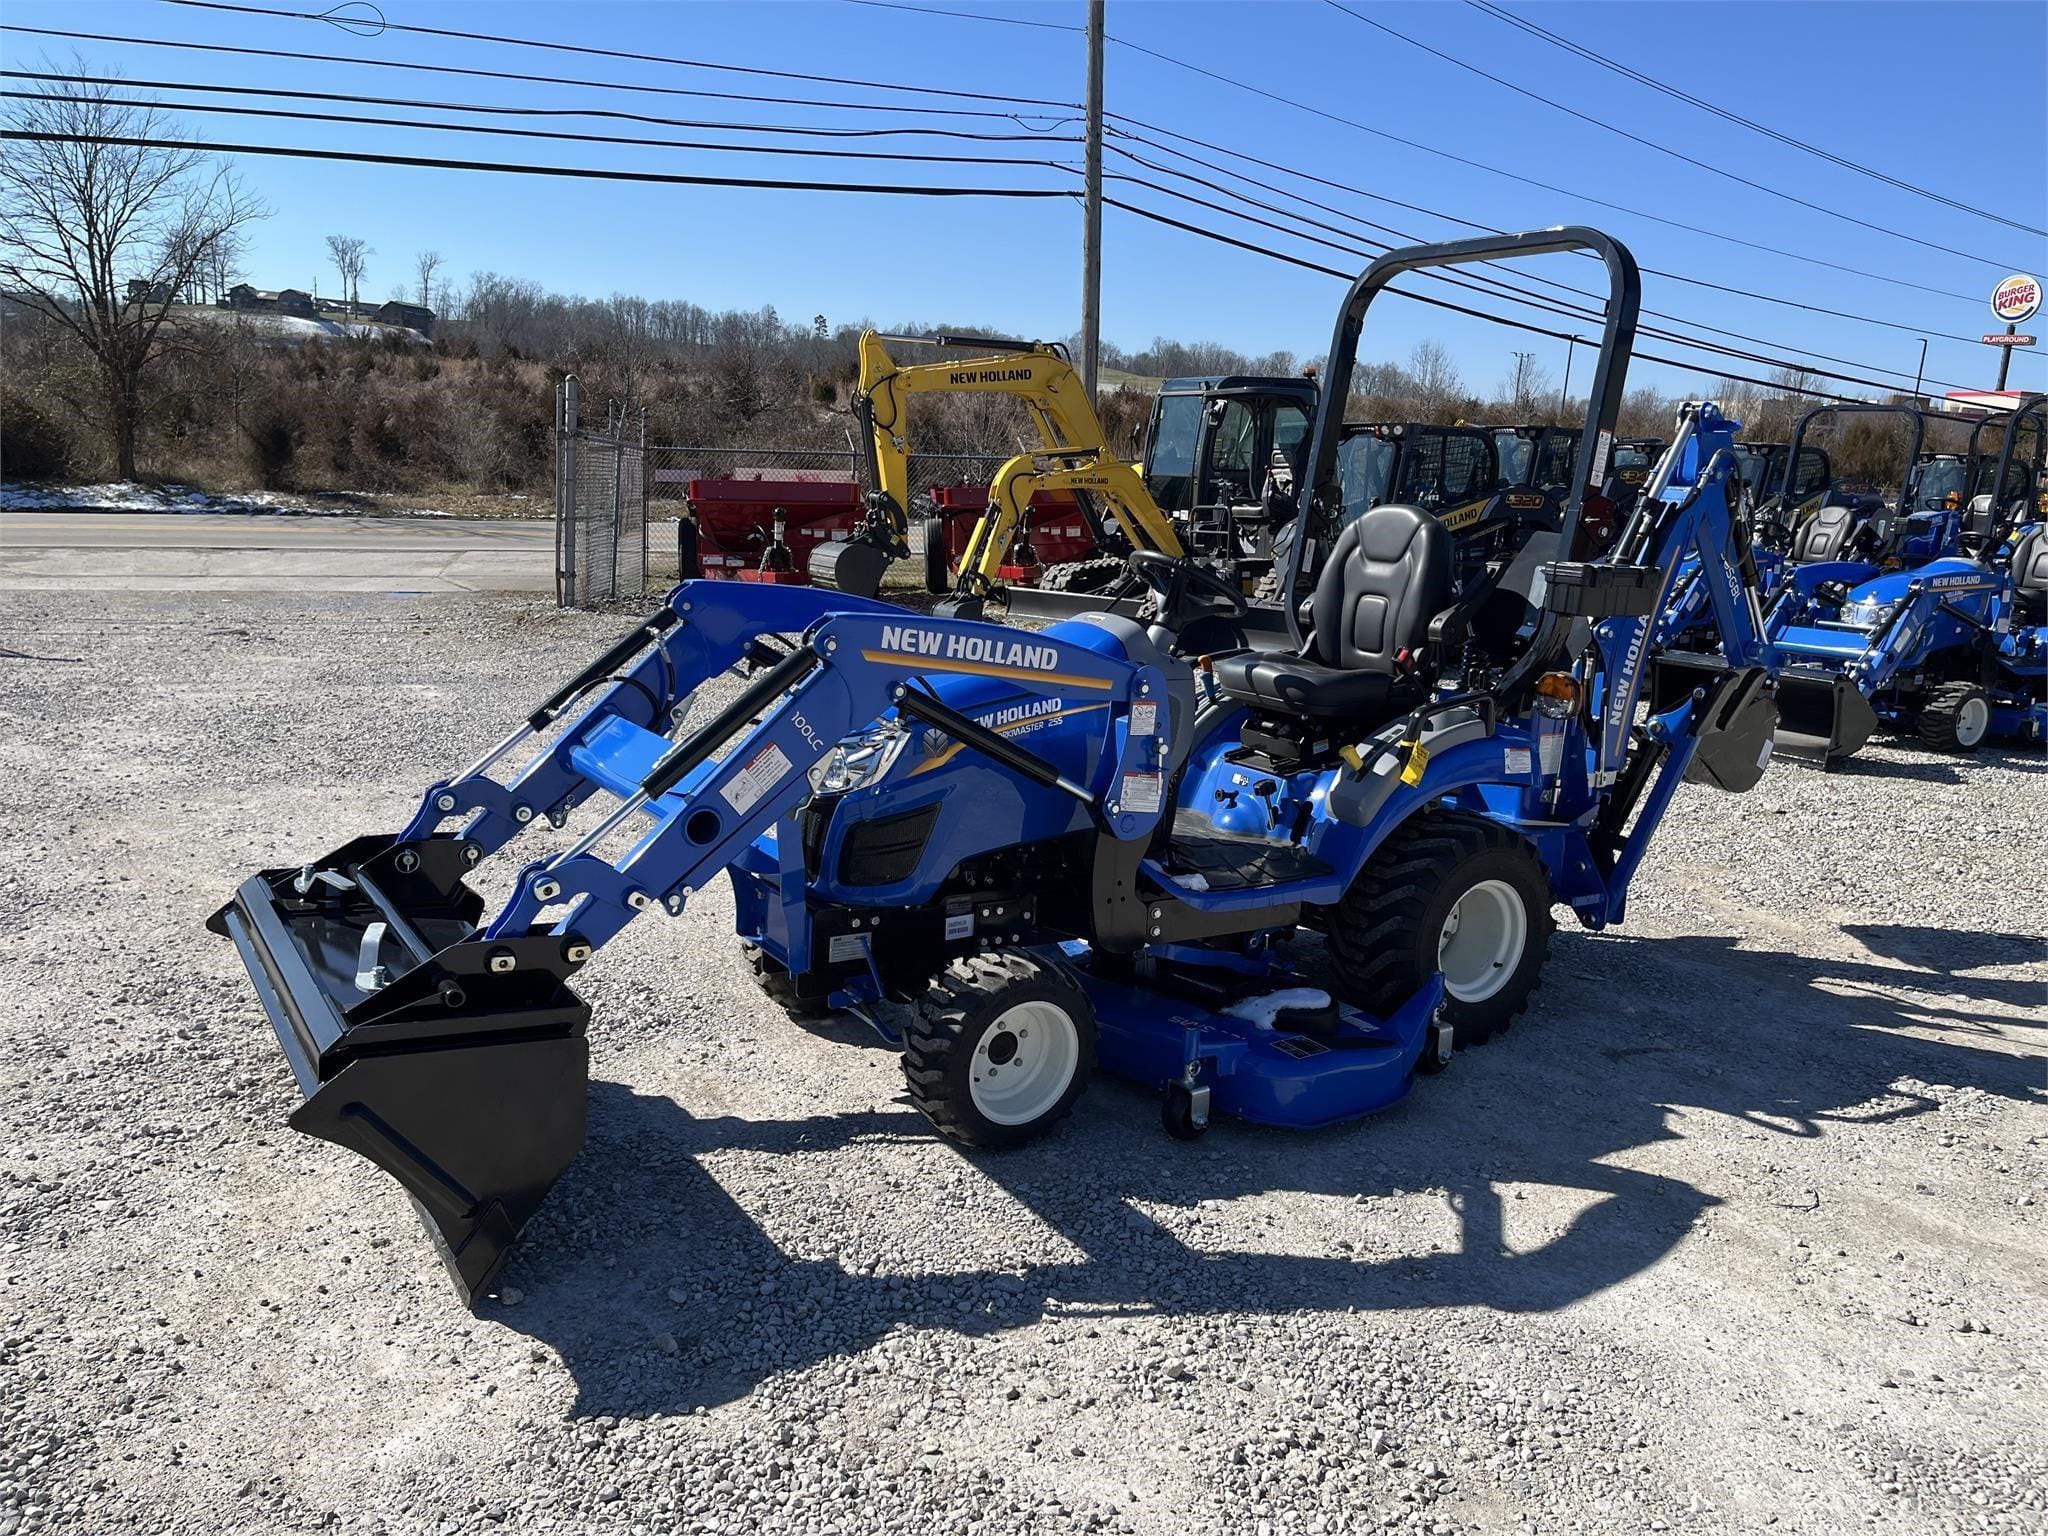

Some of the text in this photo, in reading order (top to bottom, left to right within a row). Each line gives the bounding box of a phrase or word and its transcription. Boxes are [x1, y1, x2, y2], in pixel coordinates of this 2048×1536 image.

[1997, 292, 2035, 312] KING
[1998, 284, 2035, 300] BURGER
[950, 369, 1032, 384] NEW HOLLAND
[1084, 477, 1109, 485] HOLLAND
[1443, 508, 1478, 528] OLLAND
[1932, 575, 1981, 587] NEW HOLLAND
[881, 625, 1058, 671] NEW HOLLAND
[1609, 614, 1650, 725] NEW HOLLA
[997, 698, 1062, 725] HOLLAND
[791, 712, 824, 751] 100LC
